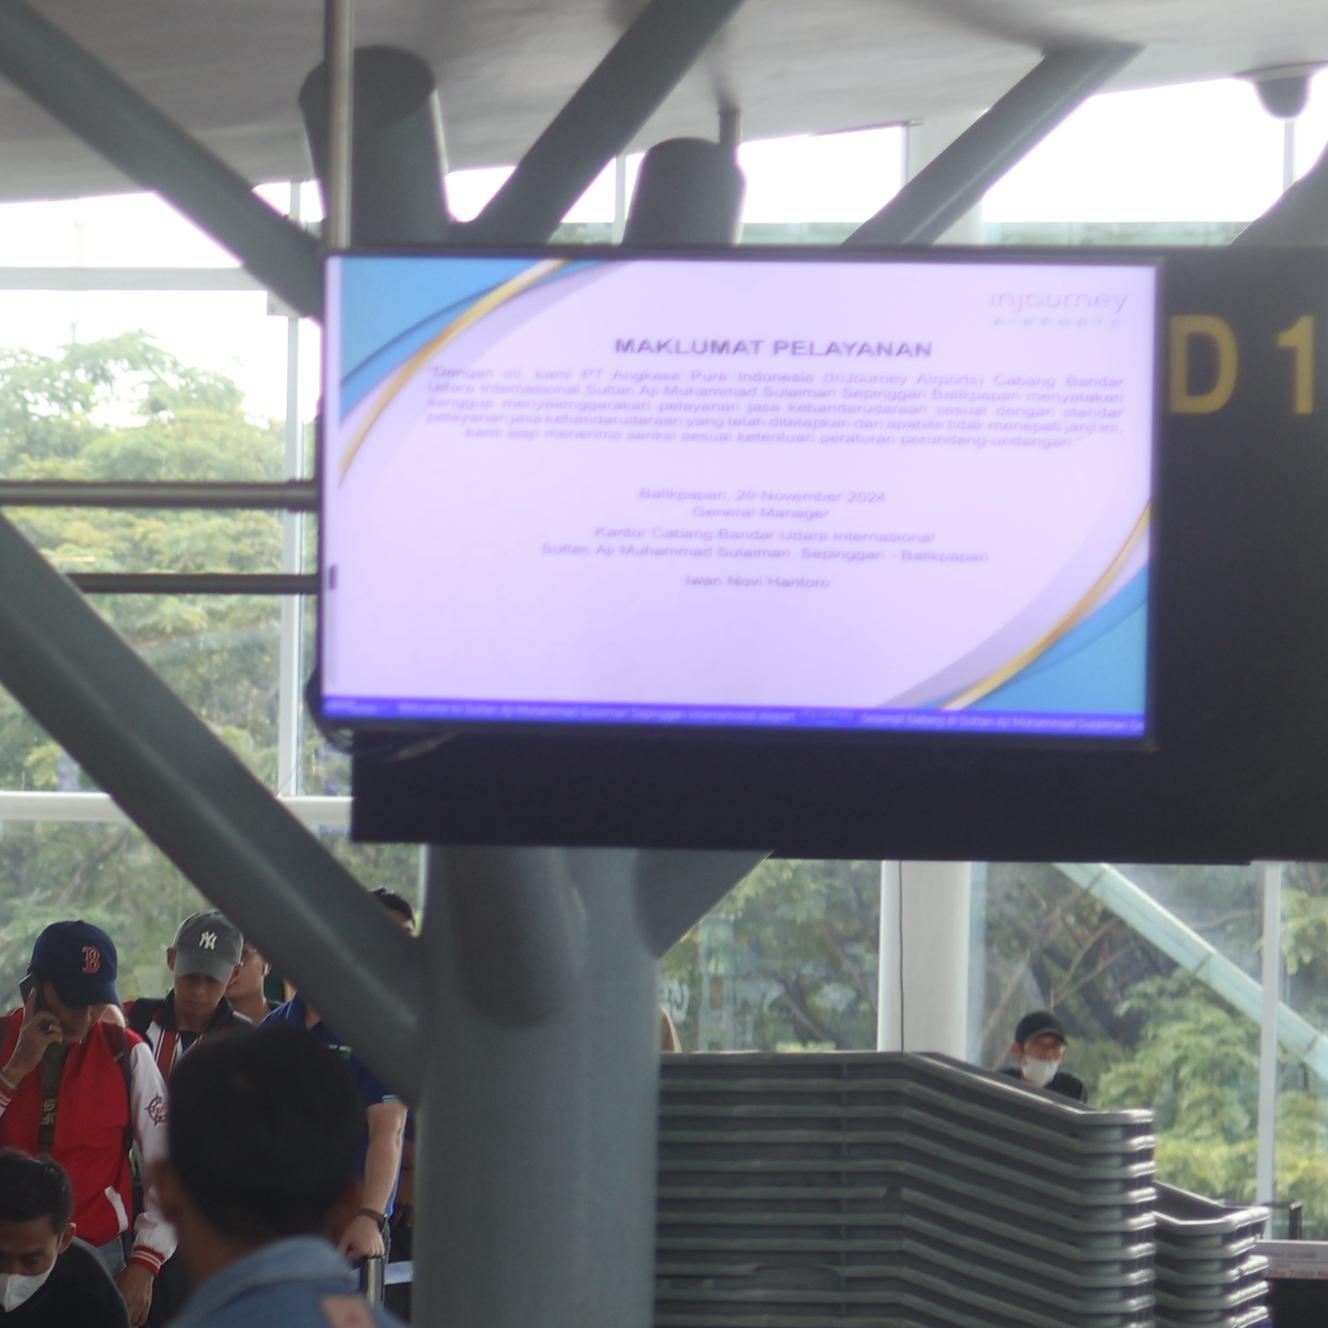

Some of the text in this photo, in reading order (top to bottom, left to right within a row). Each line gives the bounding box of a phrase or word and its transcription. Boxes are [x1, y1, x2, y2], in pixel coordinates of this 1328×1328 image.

[615, 339, 932, 358] MAKLUMAT PELAYANAN
[1169, 315, 1314, 415] D 1
[82, 945, 101, 974] B
